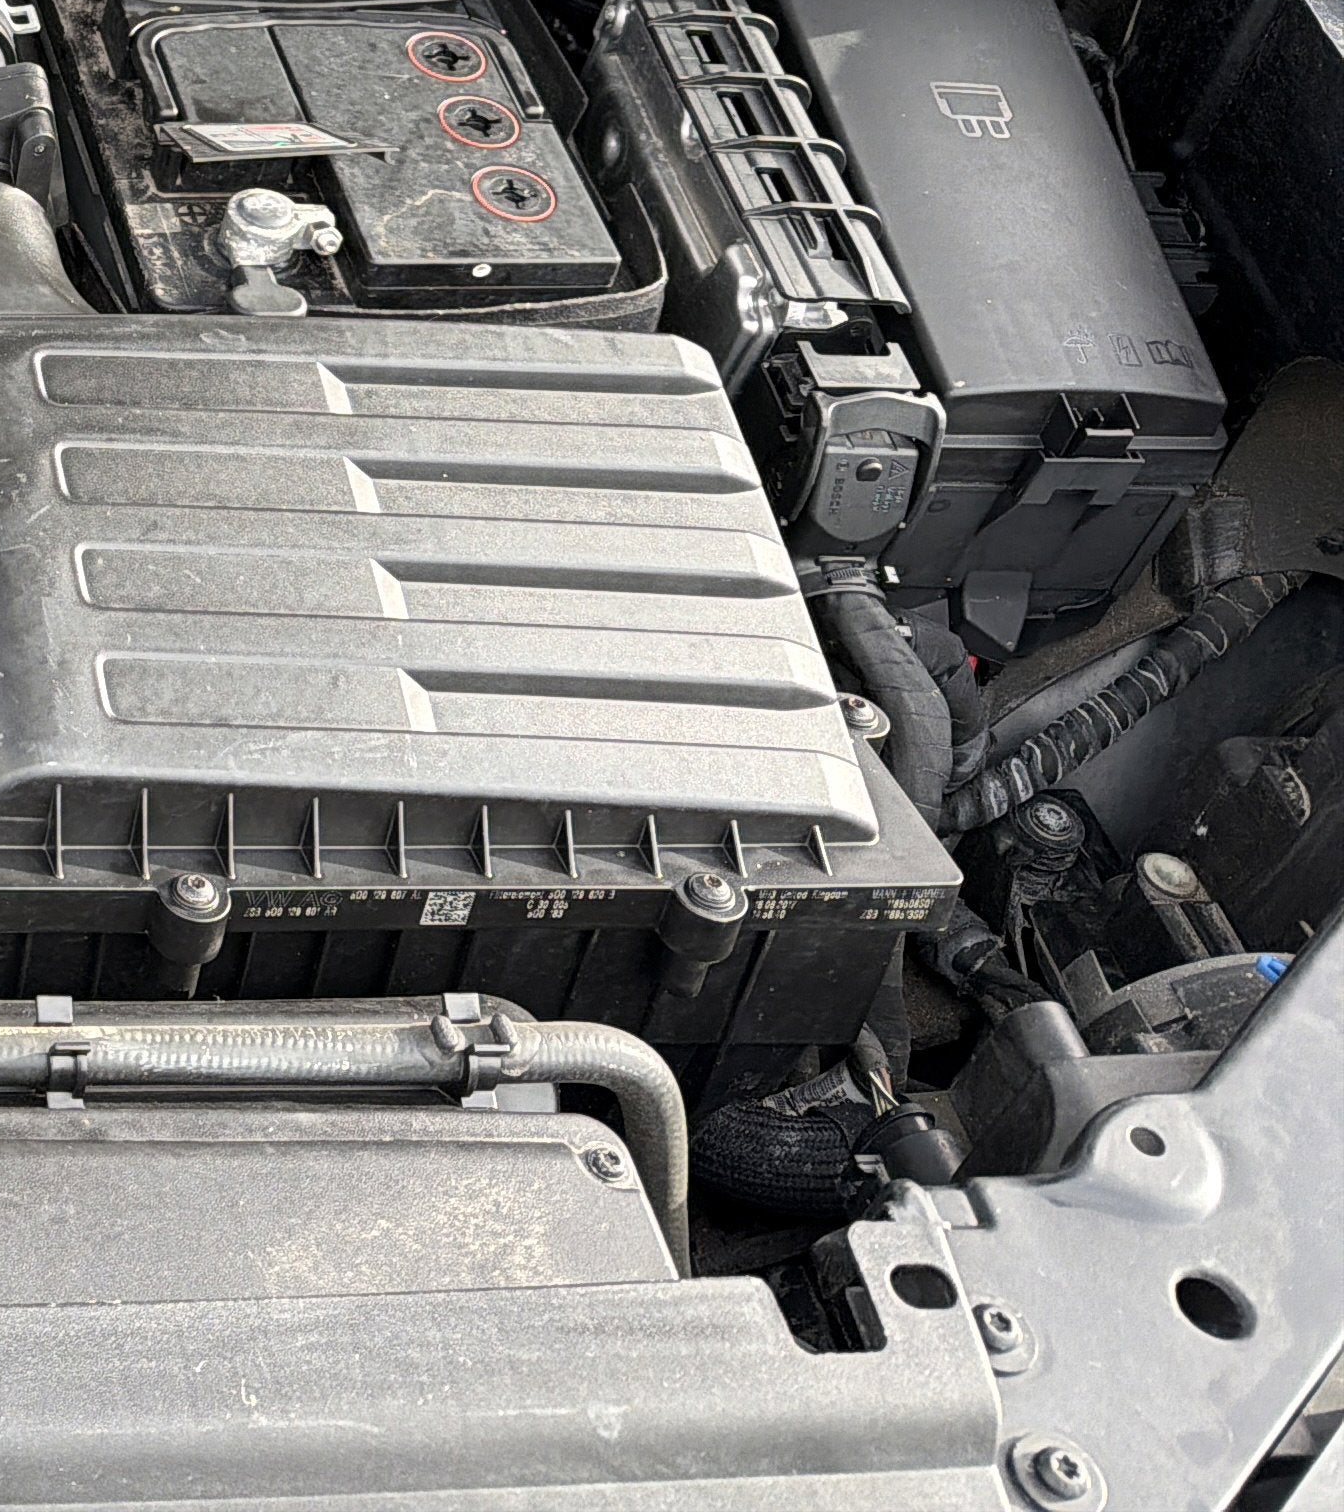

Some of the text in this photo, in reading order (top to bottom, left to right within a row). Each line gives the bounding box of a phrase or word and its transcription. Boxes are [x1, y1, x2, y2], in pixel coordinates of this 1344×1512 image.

[829, 478, 845, 516] BOSCH
[245, 891, 343, 907] VW AG
[780, 890, 809, 900] United
[812, 890, 849, 901] Kingdom
[526, 900, 534, 910] C
